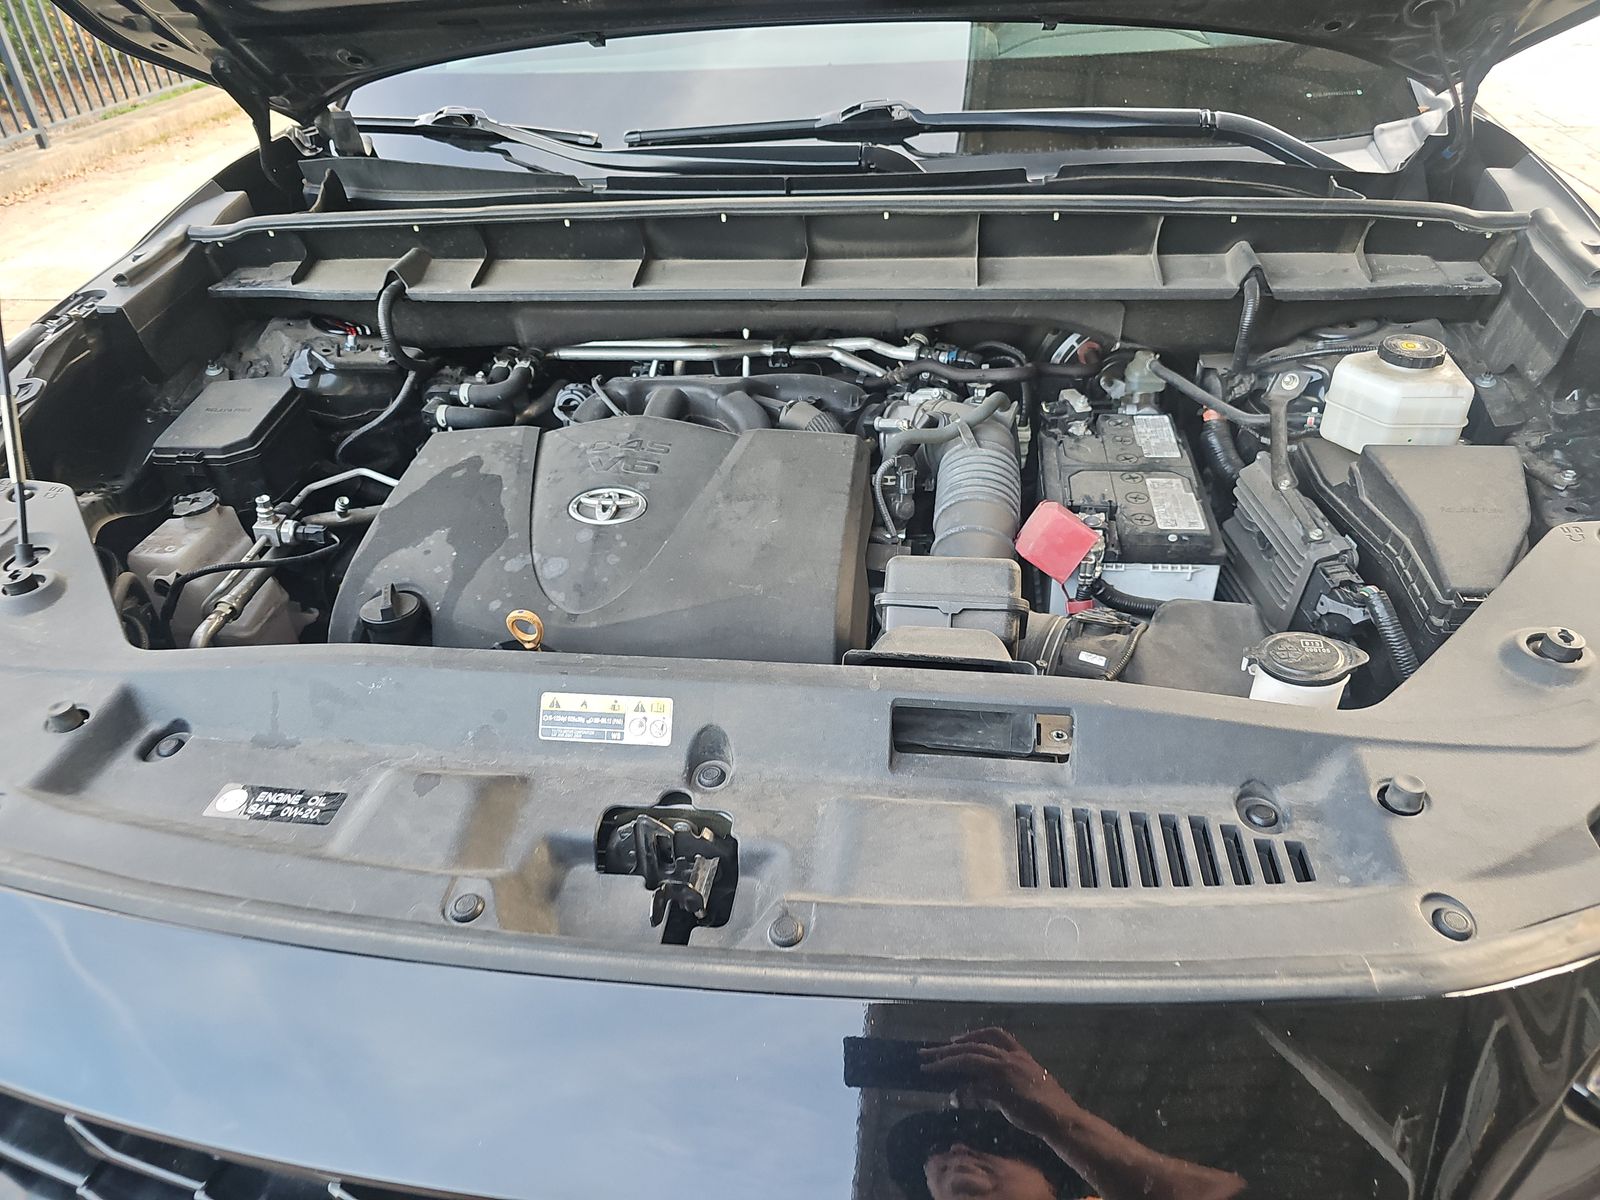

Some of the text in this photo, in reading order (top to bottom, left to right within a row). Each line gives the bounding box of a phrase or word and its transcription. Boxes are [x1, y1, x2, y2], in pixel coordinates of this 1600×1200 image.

[588, 454, 660, 475] V6
[256, 792, 327, 806] ENGINE OIL
[247, 803, 320, 819] SAE 0W-20
